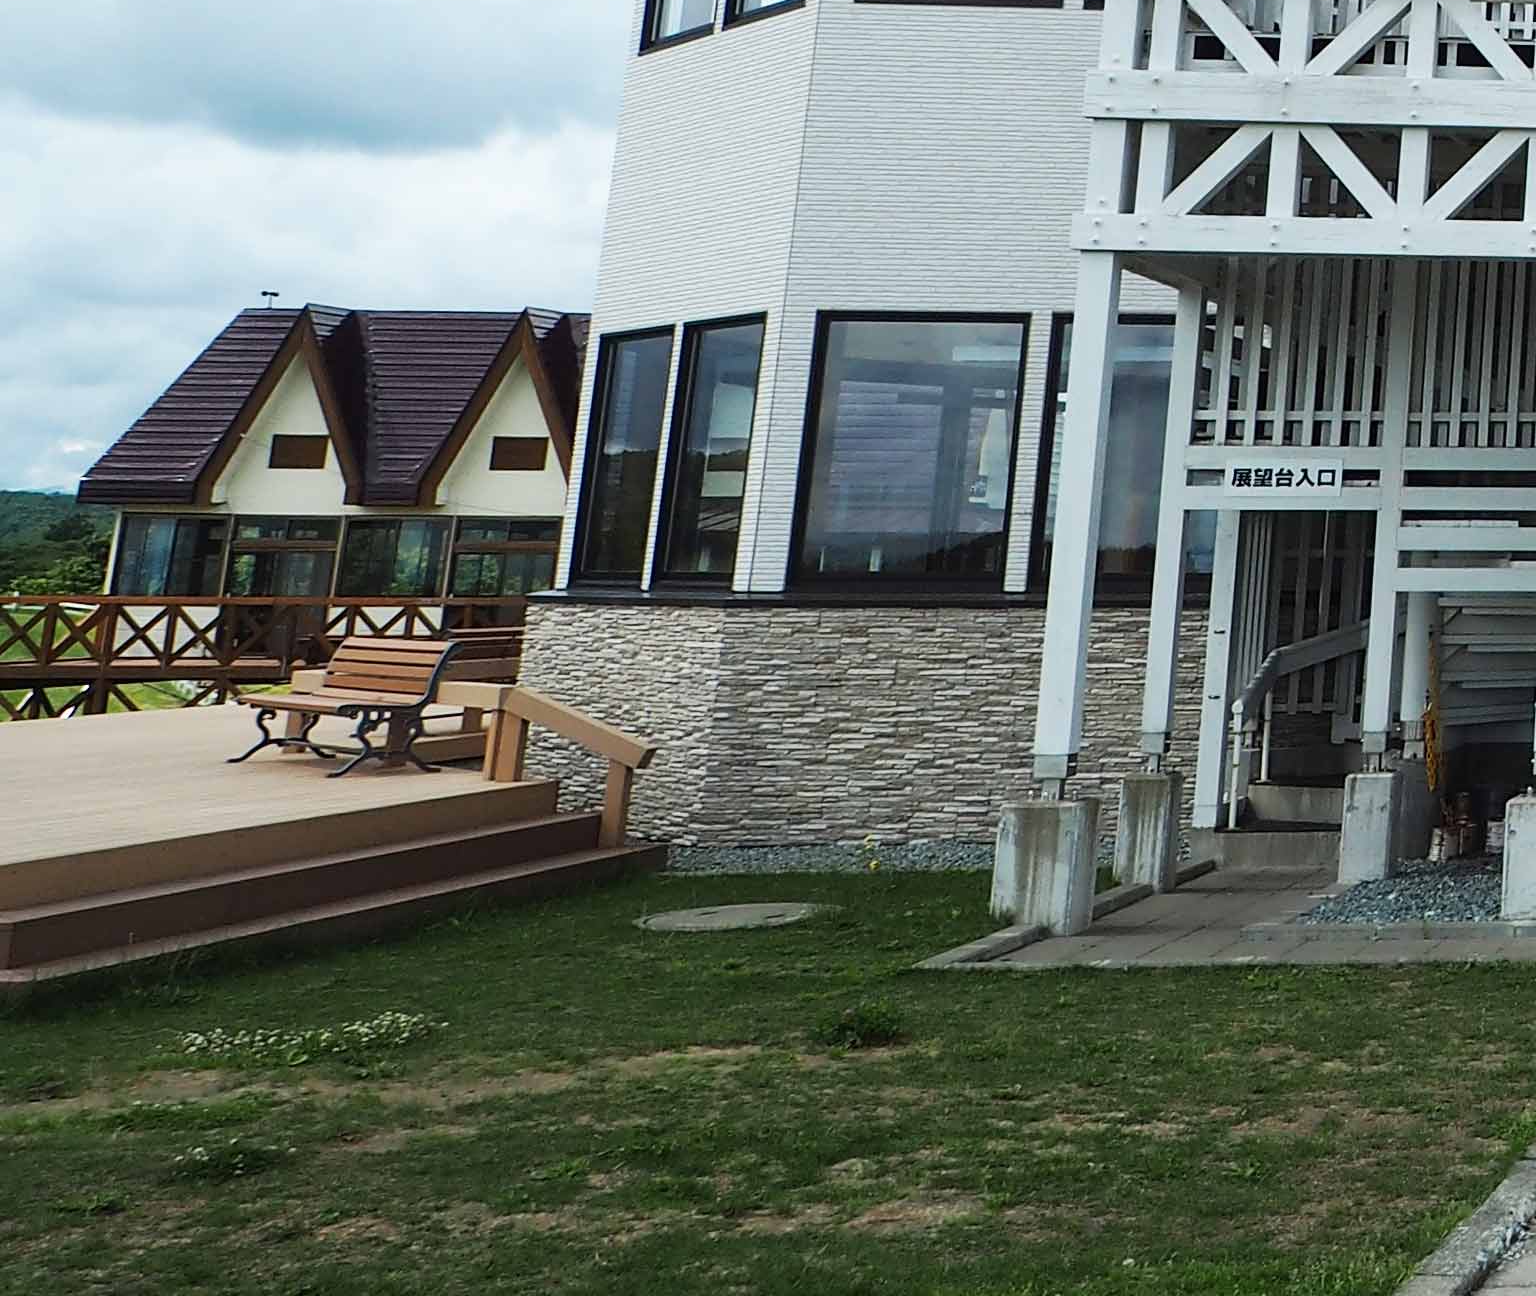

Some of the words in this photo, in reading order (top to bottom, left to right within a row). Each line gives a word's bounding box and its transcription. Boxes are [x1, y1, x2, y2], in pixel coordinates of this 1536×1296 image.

[1231, 468, 1336, 488] 展望台入口
